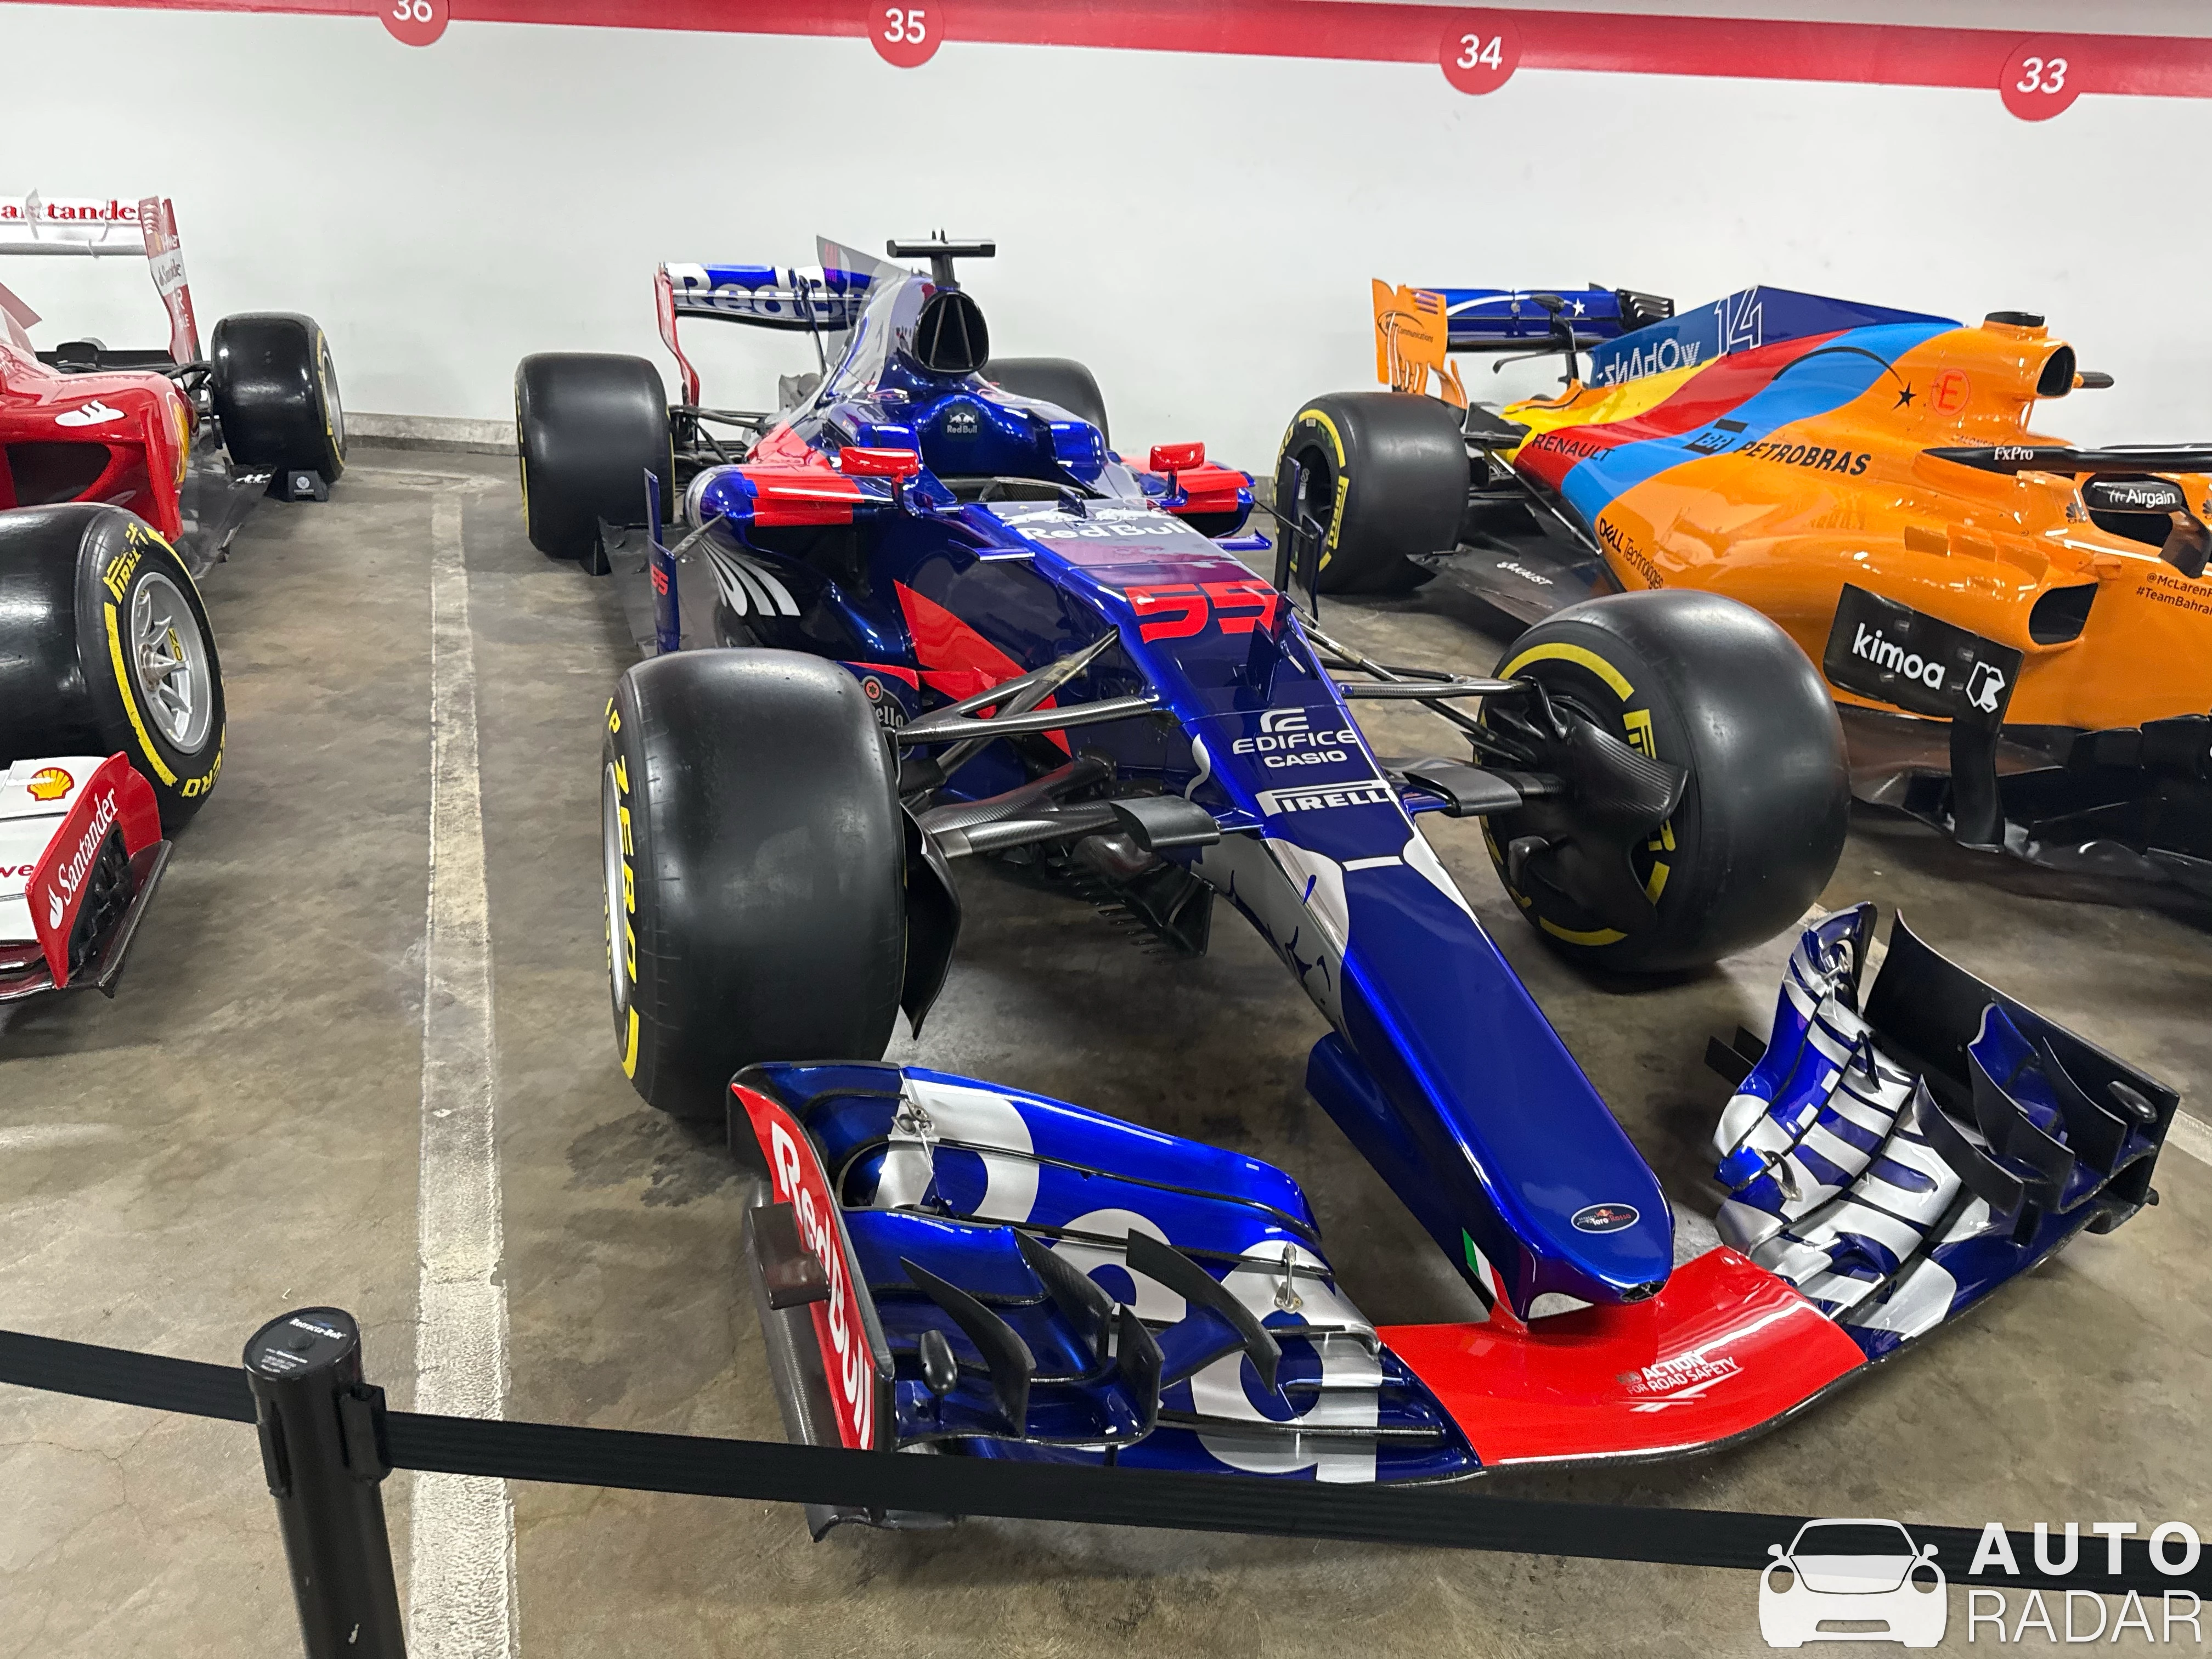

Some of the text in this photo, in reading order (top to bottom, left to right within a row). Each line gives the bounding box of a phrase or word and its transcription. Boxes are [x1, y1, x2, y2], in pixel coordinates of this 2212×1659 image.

[392, 0, 433, 23] 36
[884, 7, 926, 44] 35
[1457, 33, 1503, 71] 34
[2016, 57, 2068, 94] 33
[1714, 285, 1762, 358] 14
[947, 425, 977, 433] Red Bull
[1532, 433, 1616, 461] RENAULT
[1733, 441, 1871, 476] PETROBRAS
[1994, 447, 2034, 461] FxPro
[2125, 488, 2176, 509] Airgain
[1017, 522, 1196, 540] Red Bull
[1599, 517, 1624, 554] DELL
[1852, 622, 1945, 690] kimoa
[1232, 730, 1356, 755] EDIFICE
[1264, 750, 1347, 768] CASIO
[58, 788, 119, 906] Santander
[1590, 1217, 1609, 1226] Toro
[771, 1120, 872, 1451] Red Bull
[1641, 1352, 1707, 1380] ACTION
[1646, 1373, 1689, 1393] ROAD
[1685, 1356, 1739, 1382] SAFETY
